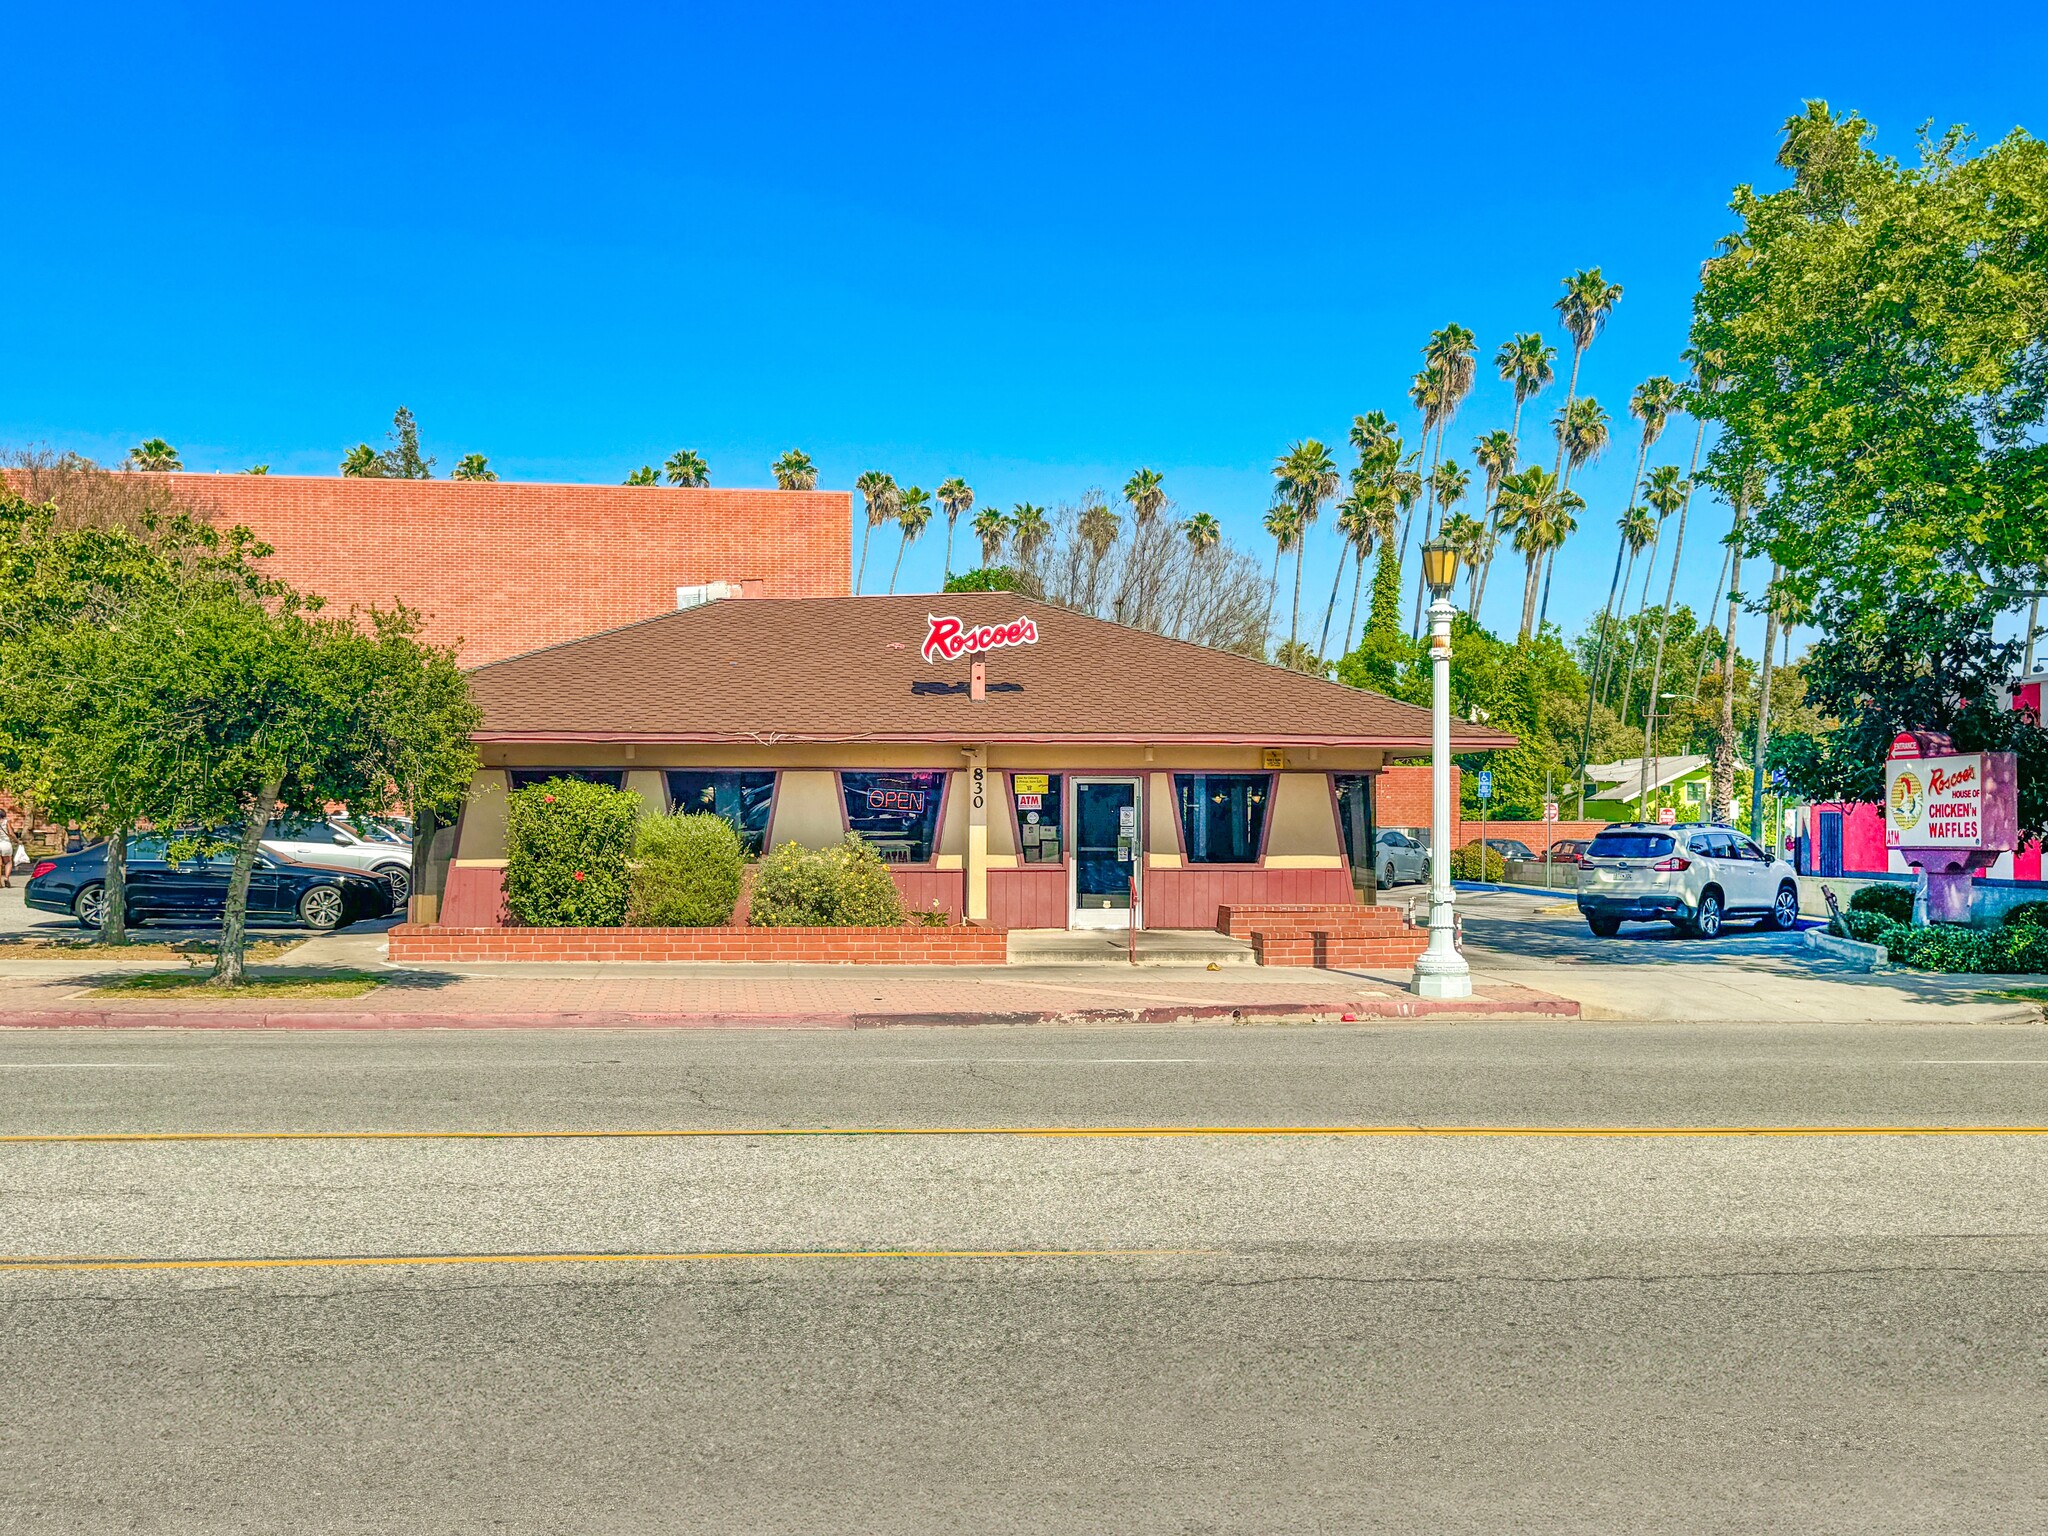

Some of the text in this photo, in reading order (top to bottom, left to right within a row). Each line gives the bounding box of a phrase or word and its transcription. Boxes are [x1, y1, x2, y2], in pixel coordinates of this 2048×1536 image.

[924, 616, 1036, 660] Roscoe's
[1894, 742, 1917, 750] ENTRANCE
[1928, 764, 1976, 797] Roscoe's
[870, 790, 922, 810] OPEN
[1020, 796, 1038, 805] ATM
[1952, 789, 1980, 798] HOUSE OF
[1887, 830, 1900, 845] ATM
[1929, 821, 1978, 838] WAFFLES
